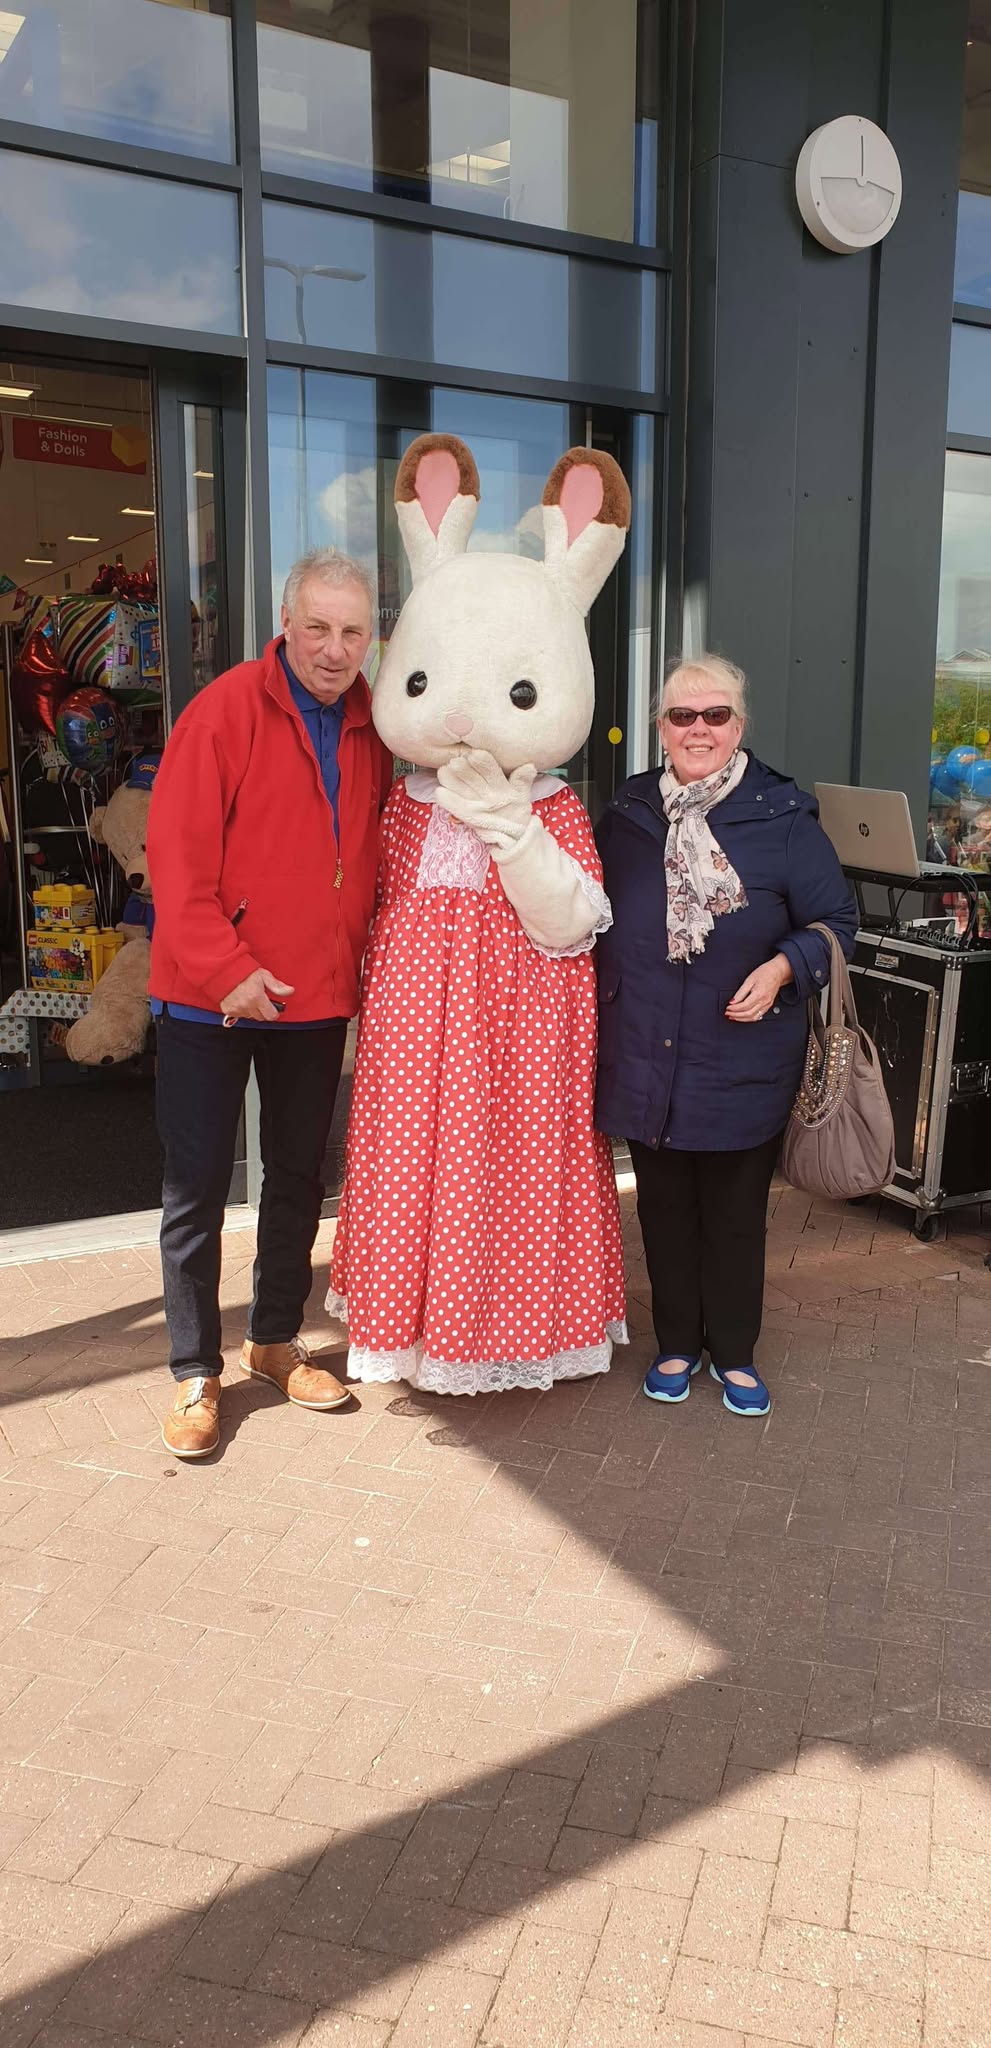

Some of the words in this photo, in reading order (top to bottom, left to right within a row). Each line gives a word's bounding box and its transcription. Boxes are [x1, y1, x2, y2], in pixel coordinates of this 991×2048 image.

[38, 426, 87, 444] Fashion
[40, 441, 50, 452] &
[54, 443, 86, 457] Dolls
